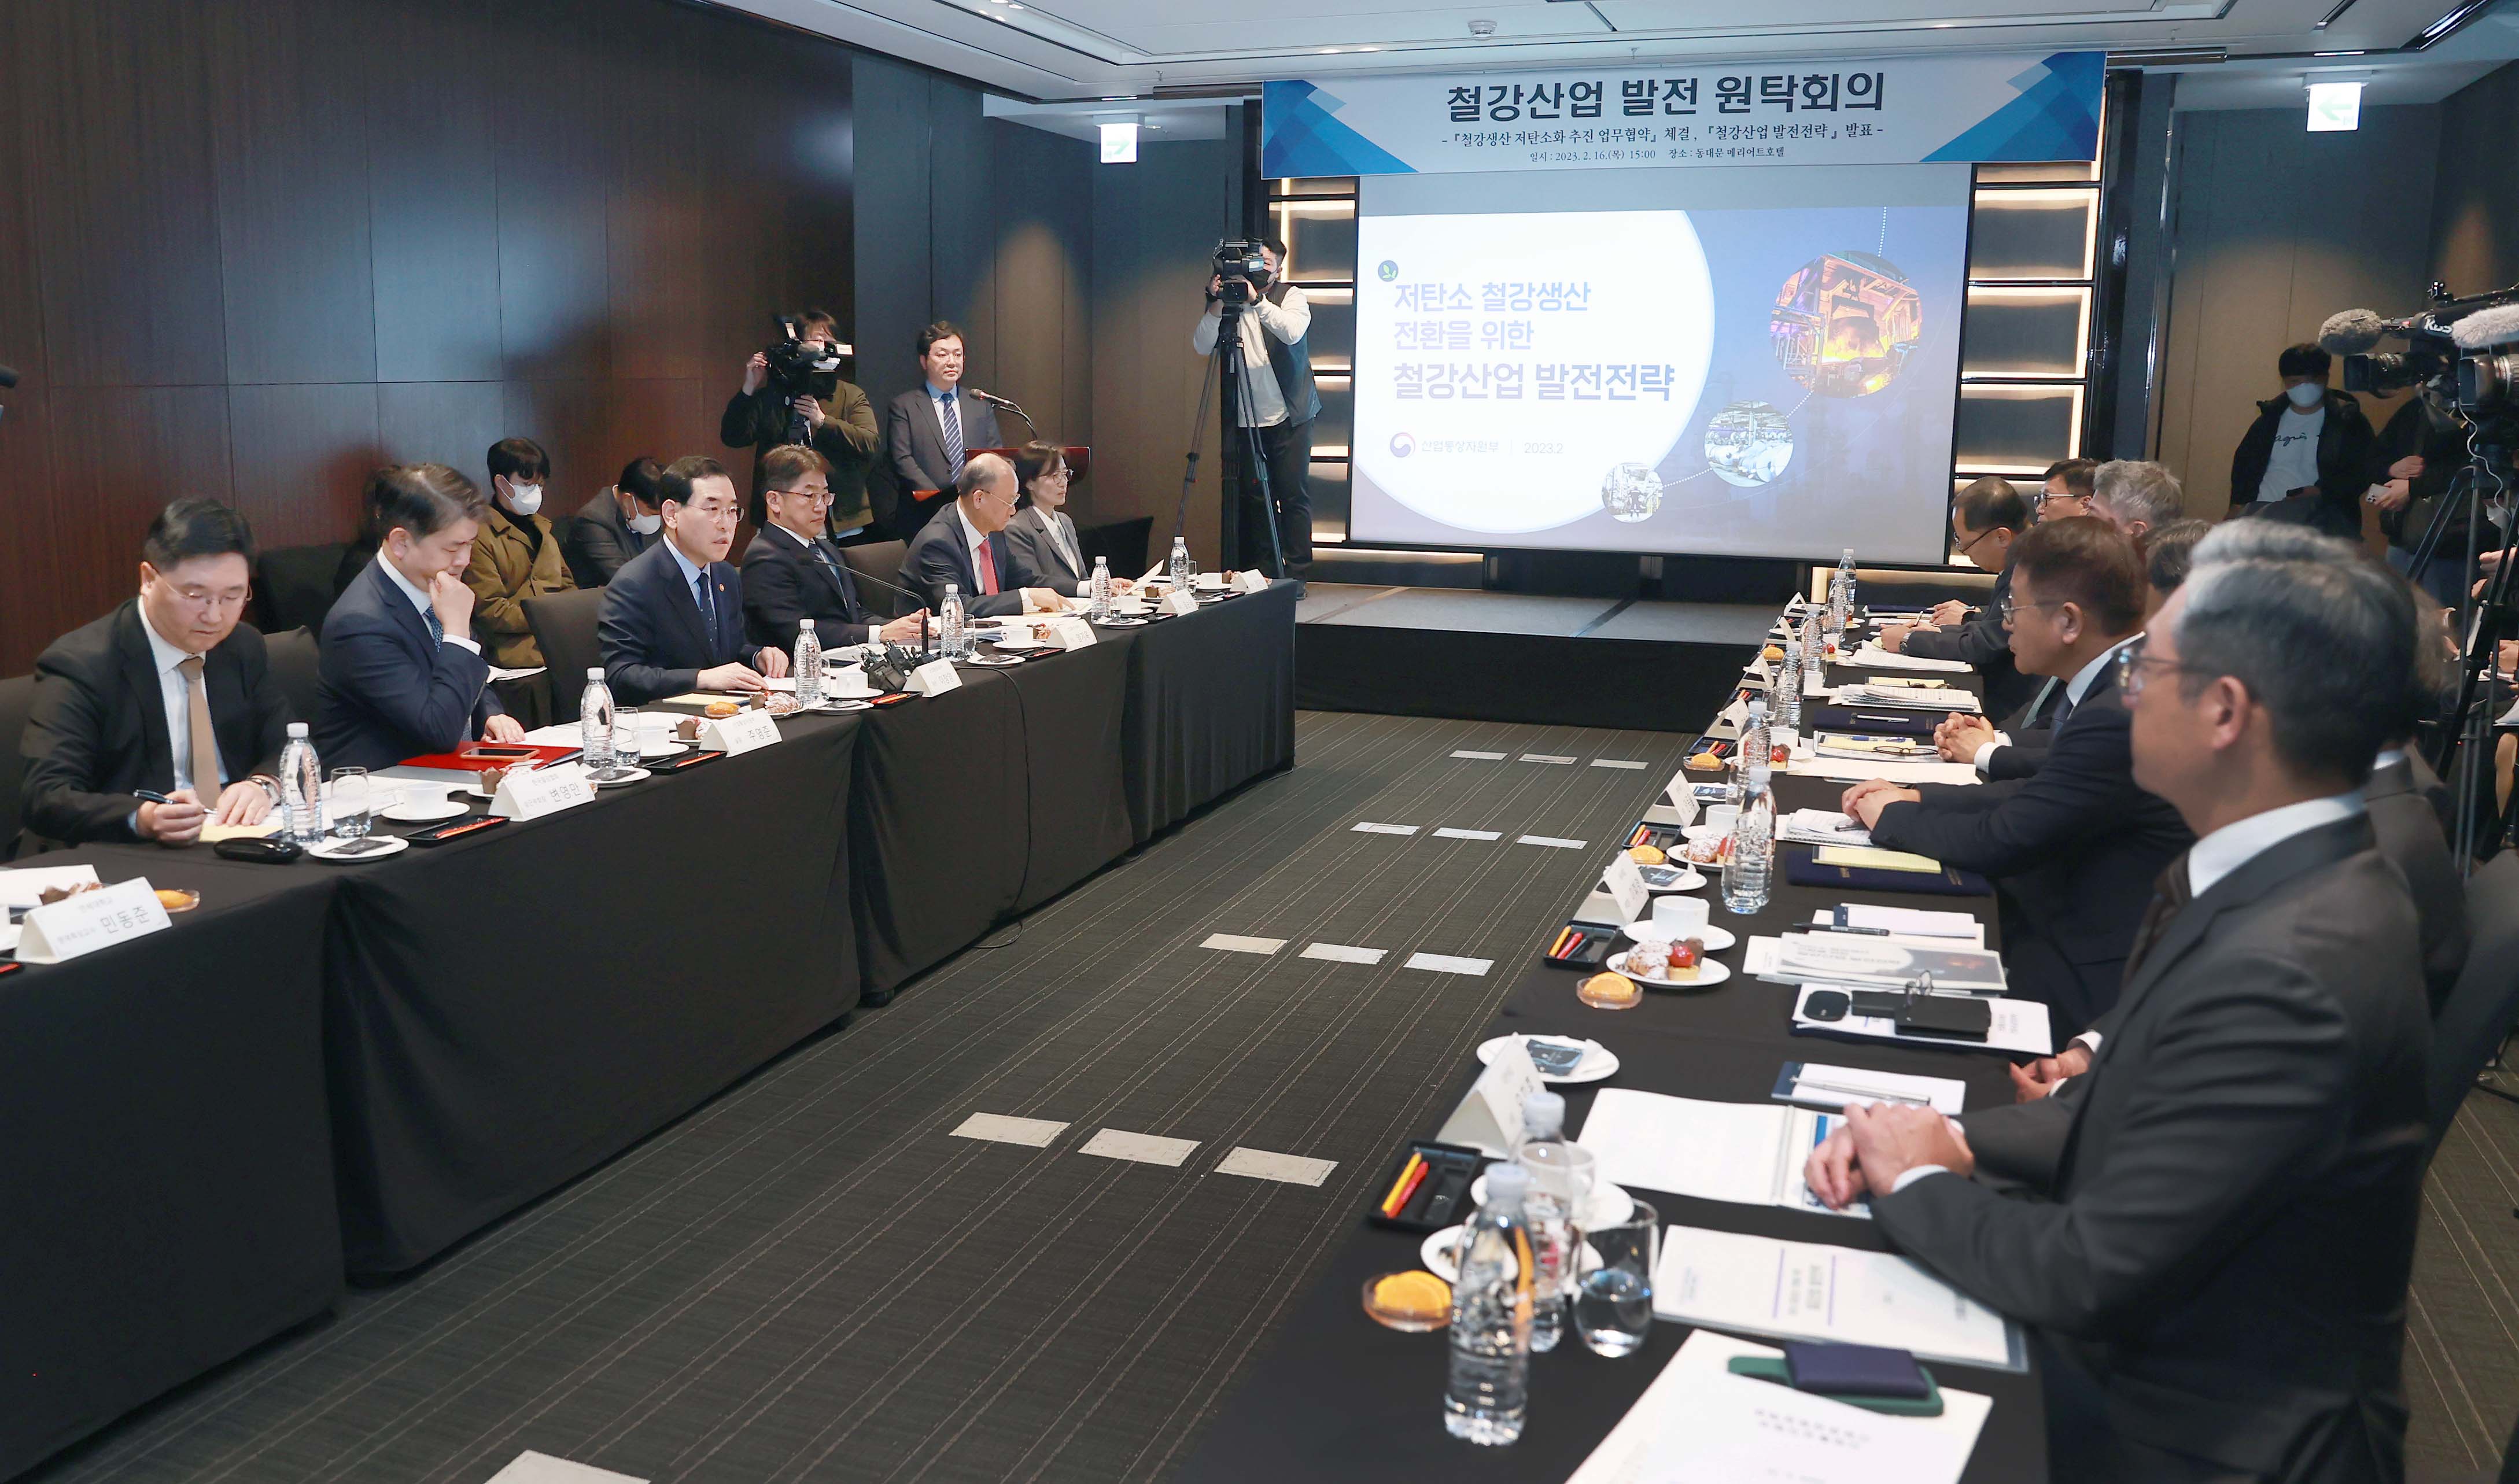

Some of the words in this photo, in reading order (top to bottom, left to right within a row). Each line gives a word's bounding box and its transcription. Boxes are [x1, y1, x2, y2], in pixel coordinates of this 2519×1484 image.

[1447, 81, 1603, 122] 철강산업
[1621, 78, 1698, 116] 발전
[1715, 72, 1884, 114] 원탁회의
[1514, 130, 1565, 145] 저탄소화
[1568, 128, 1594, 144] 추진
[1845, 122, 1873, 138] 발표
[1629, 150, 1655, 160] 15:00
[1695, 147, 1724, 158] 동대문
[1394, 282, 1473, 312] 저탄소
[1481, 282, 1591, 312] 철강생산
[1394, 320, 1473, 350] 전환을
[1481, 320, 1535, 350] 위한
[1393, 363, 1524, 400] 철강산업
[1536, 364, 1675, 401] 발전전략
[1421, 440, 1499, 453] 산업통상자원부
[1524, 442, 1563, 455] 2023.2
[99, 906, 150, 934] 민동준
